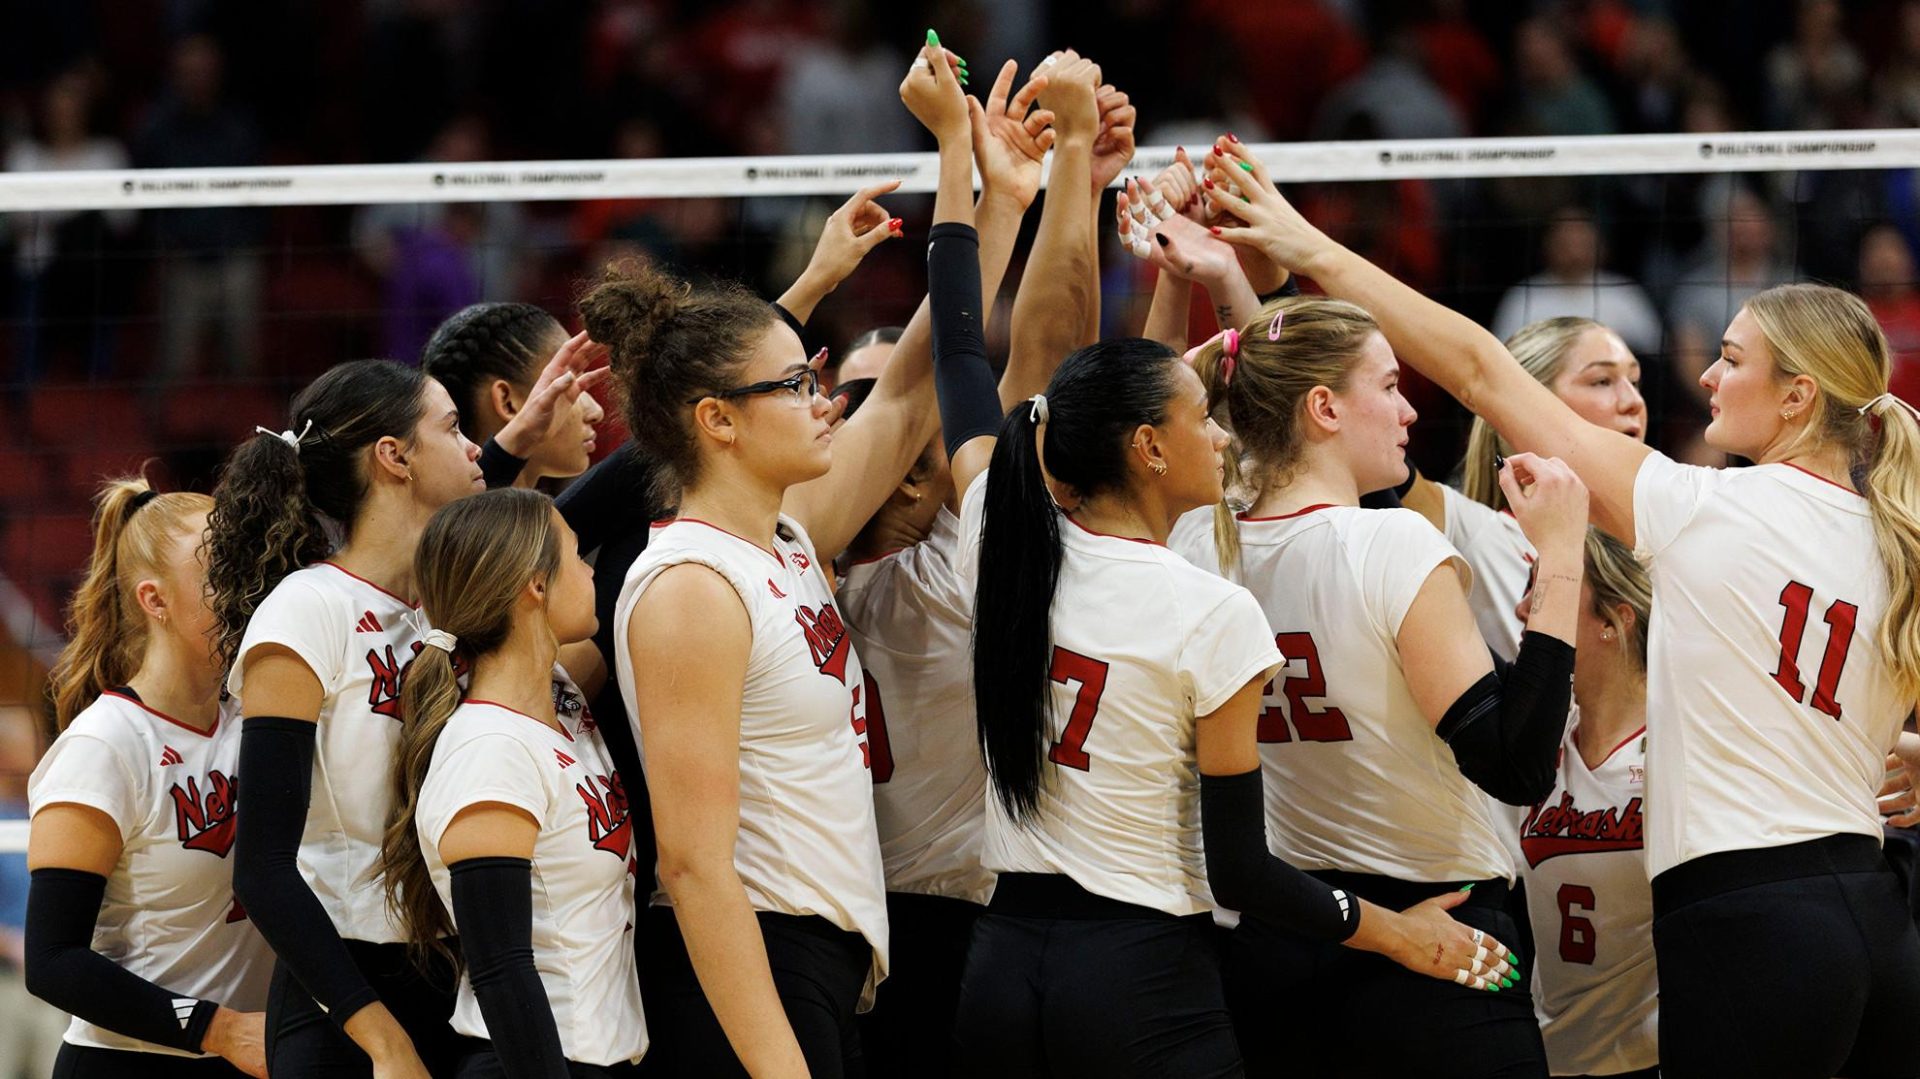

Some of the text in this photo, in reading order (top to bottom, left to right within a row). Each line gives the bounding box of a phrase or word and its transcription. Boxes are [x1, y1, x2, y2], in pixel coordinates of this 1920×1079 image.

[1049, 645, 1109, 772] 7
[1769, 580, 1858, 721] 11
[1557, 883, 1596, 965] 6
